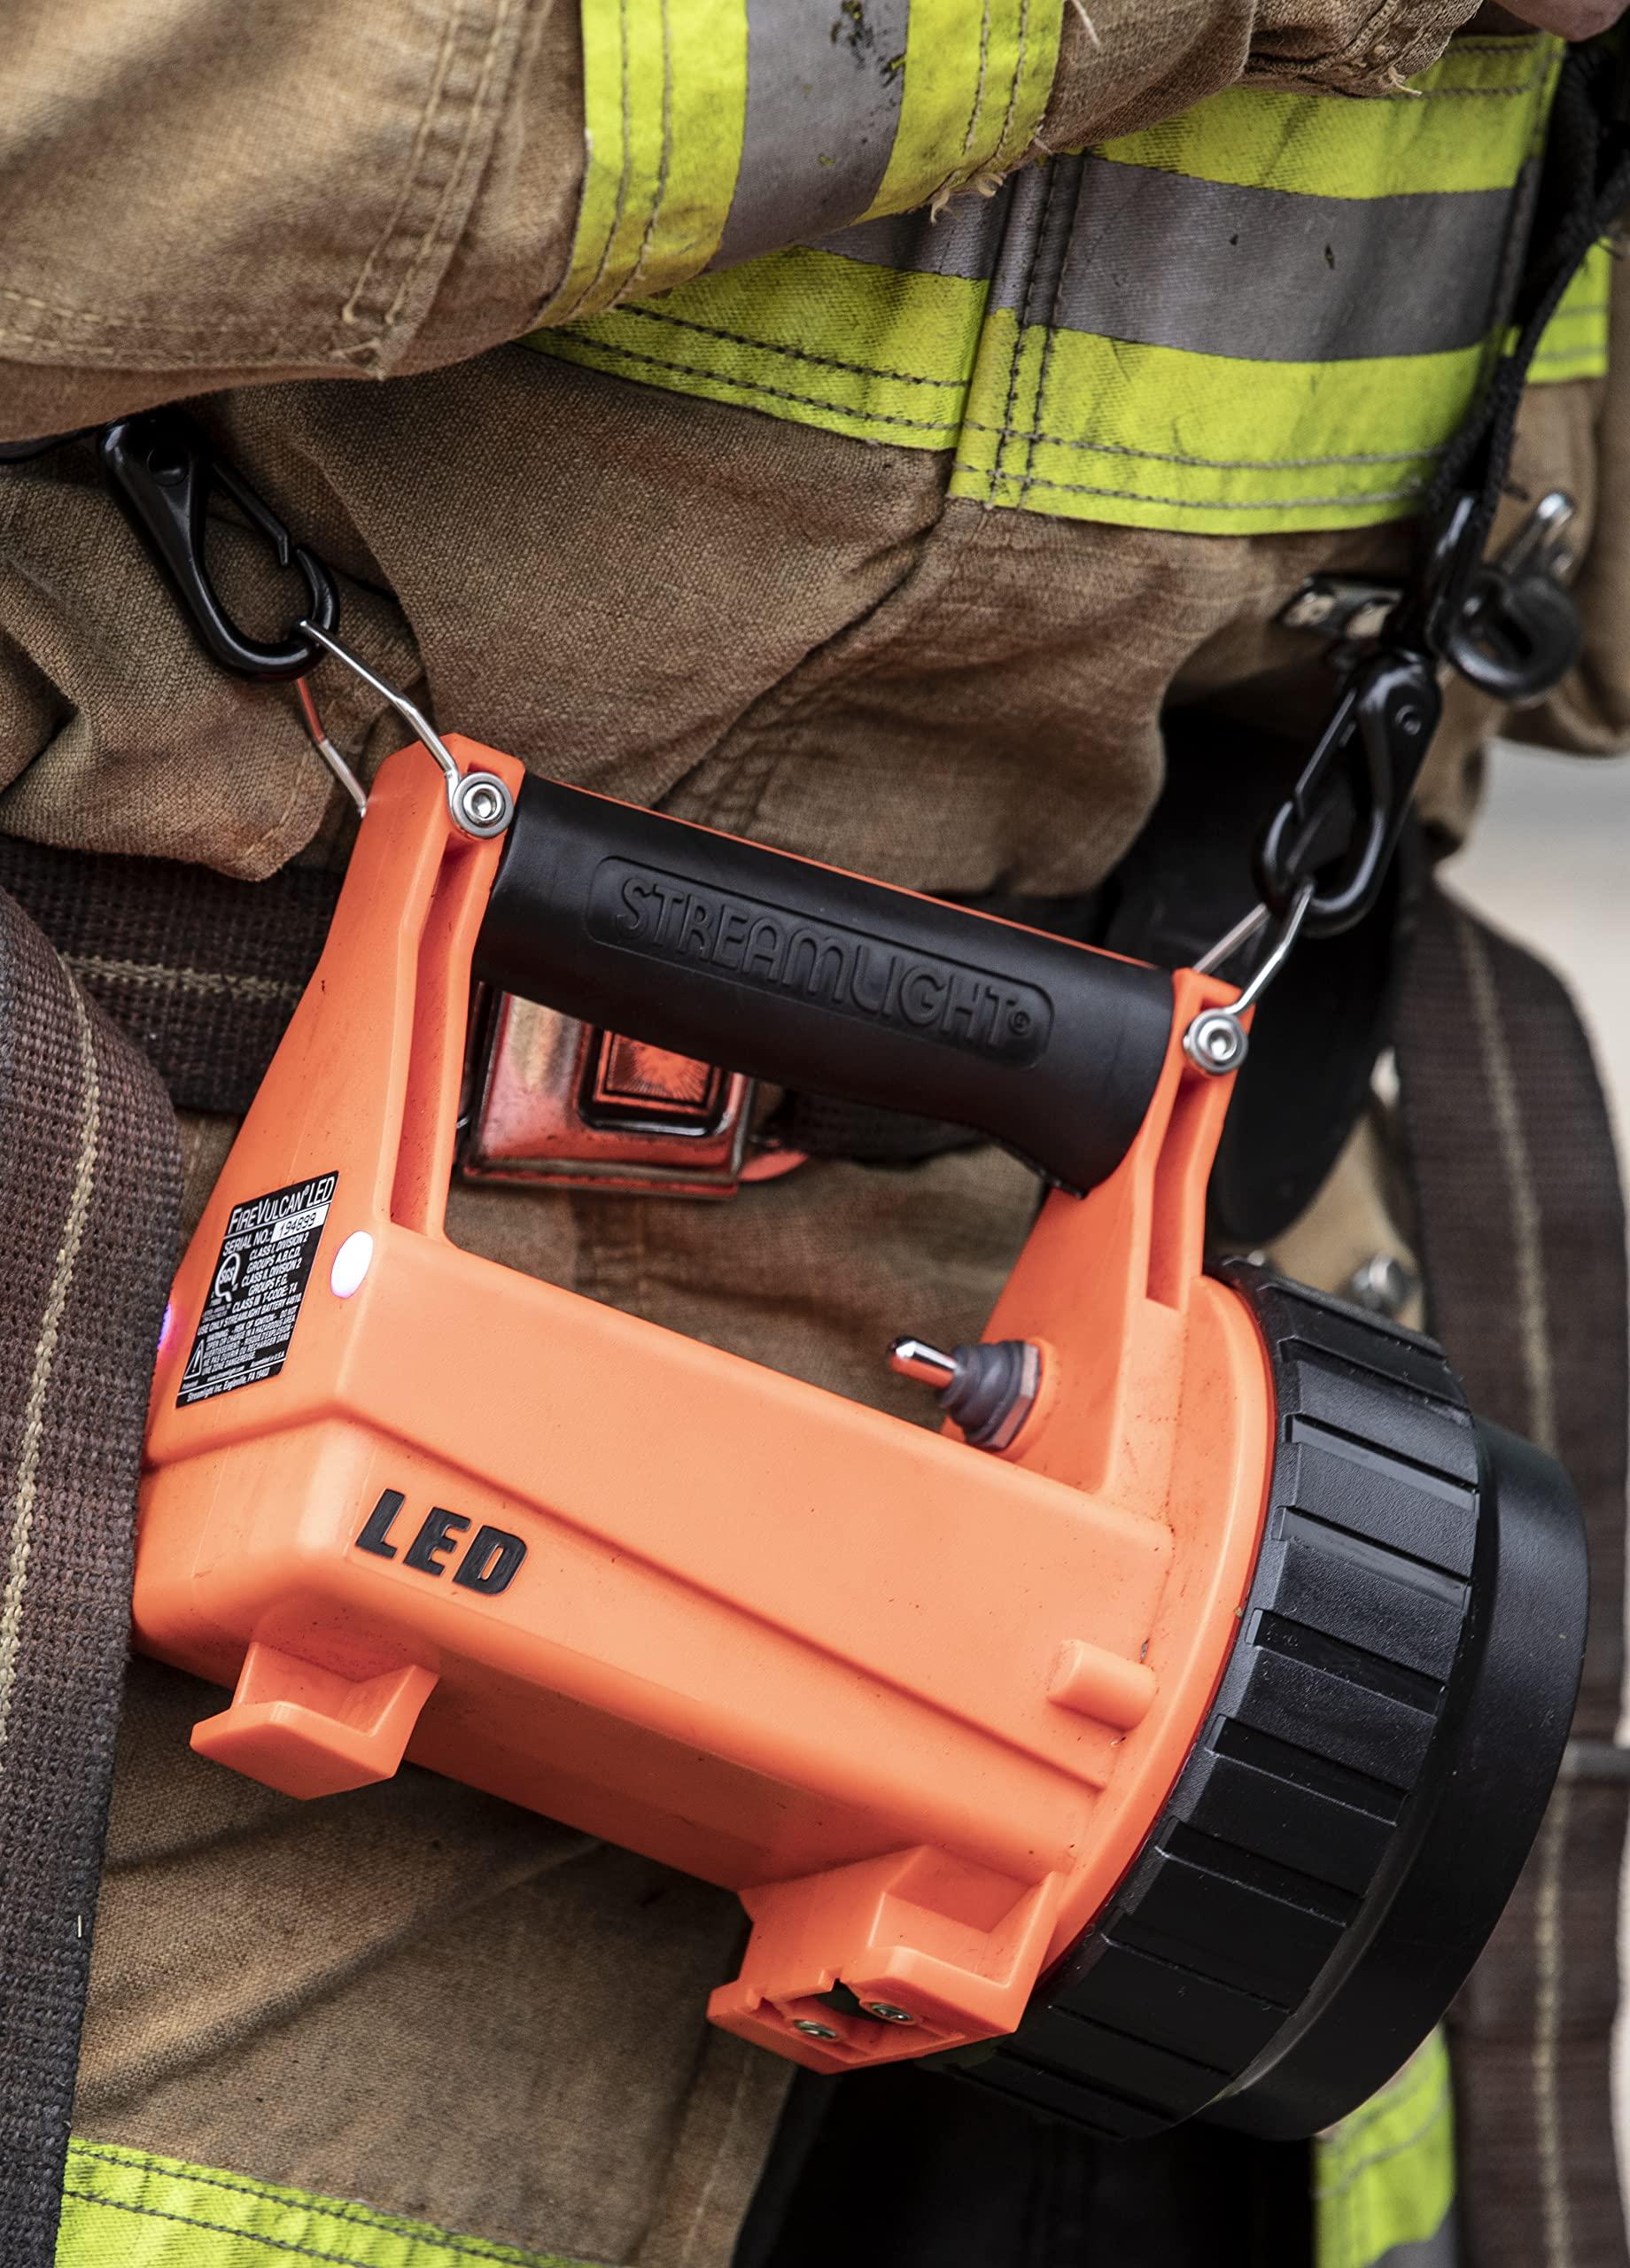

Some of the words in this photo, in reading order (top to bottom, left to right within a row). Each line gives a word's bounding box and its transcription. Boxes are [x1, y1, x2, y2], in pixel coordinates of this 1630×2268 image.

[307, 1177, 336, 1207] LED
[222, 1234, 253, 1255] SERIAL
[253, 1227, 273, 1246] NO.:
[279, 1213, 316, 1236] 194899
[249, 1245, 271, 1260] CLASS
[276, 1234, 303, 1250] DIVISION
[304, 1232, 309, 1241] 2
[219, 1267, 235, 1284] SGS
[241, 1271, 263, 1286] CLASS
[269, 1260, 296, 1277] DIVISION
[296, 1258, 302, 1268] 2
[246, 1255, 275, 1272] GROUPS
[232, 1297, 254, 1312] CLASS
[288, 1283, 298, 1293] T4
[248, 1278, 276, 1295] GROUPS
[198, 1324, 209, 1335] USE
[209, 1319, 224, 1331] ONLY
[224, 1307, 261, 1326] STREAMLIGHT
[261, 1299, 285, 1313] BATTERY
[247, 1372, 255, 1381] PA
[355, 1487, 528, 1596] LED
